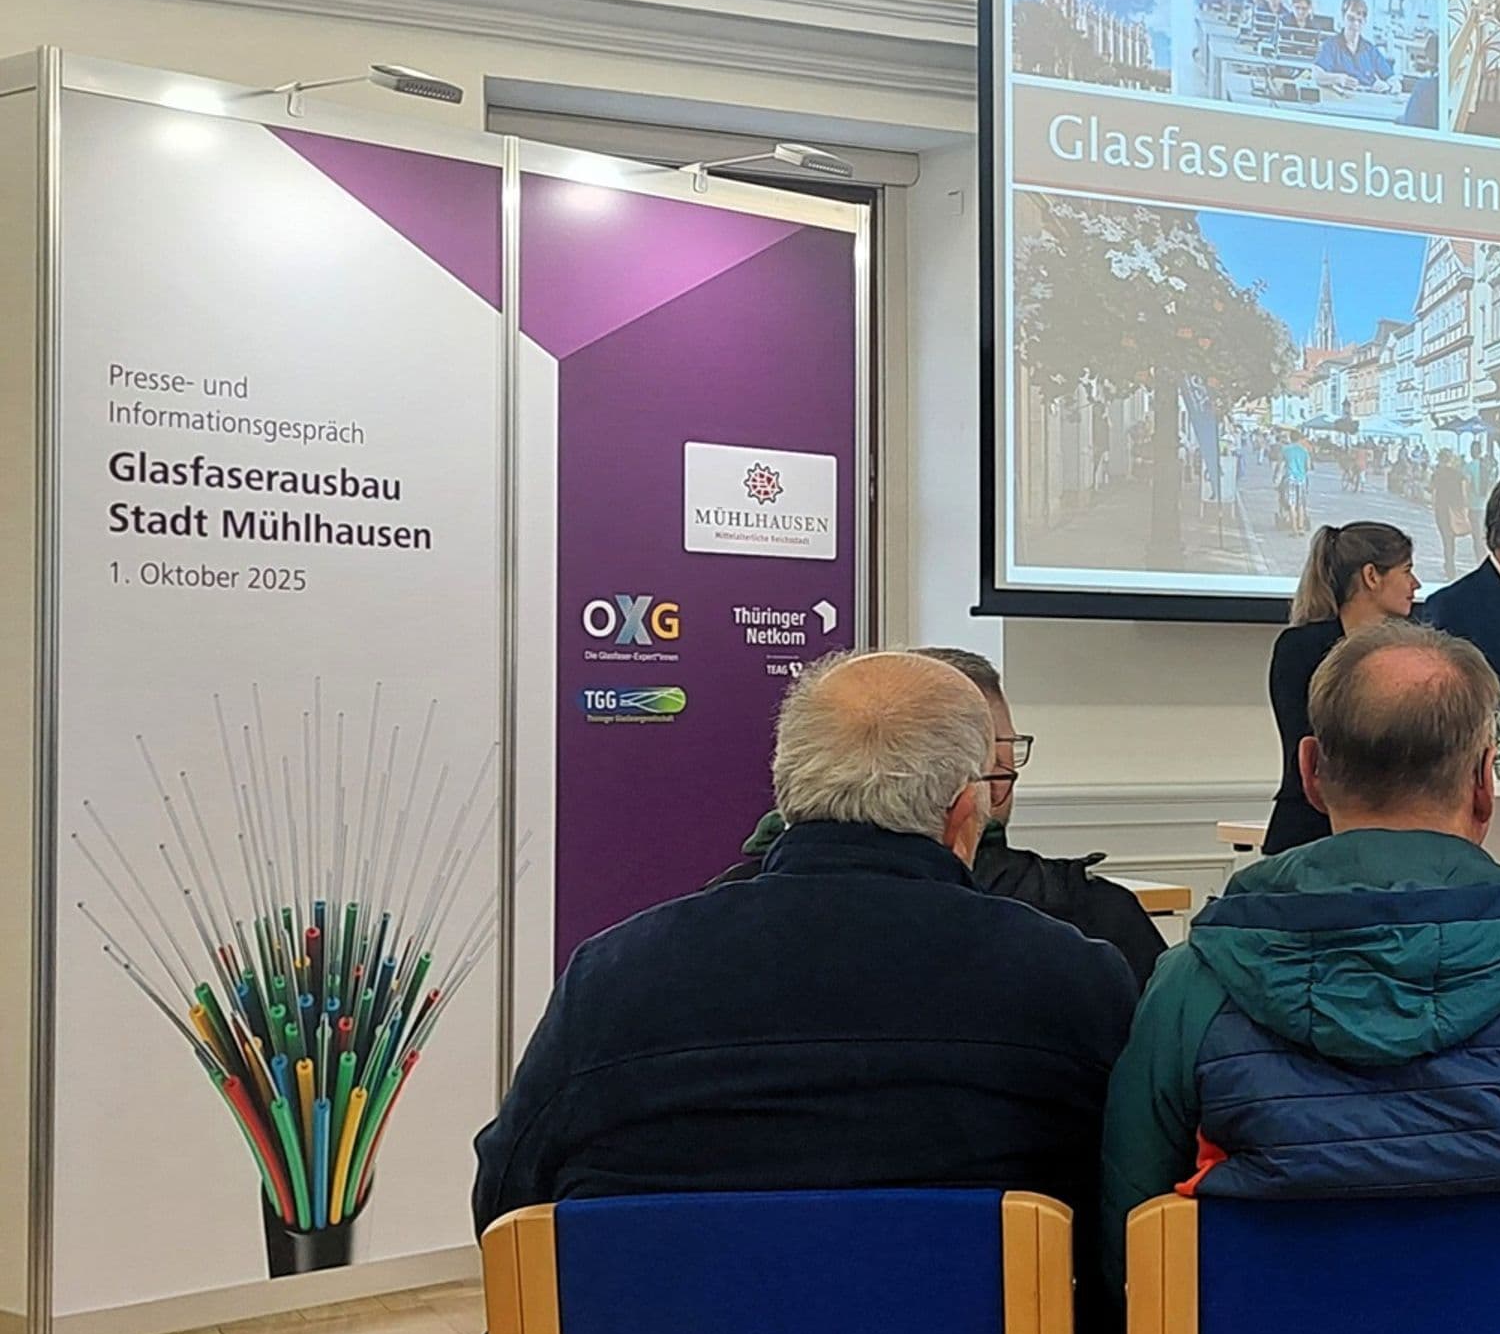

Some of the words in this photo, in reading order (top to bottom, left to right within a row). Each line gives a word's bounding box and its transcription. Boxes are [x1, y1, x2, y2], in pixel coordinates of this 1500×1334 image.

[1049, 114, 1444, 204] Glasfaserausbau
[1463, 167, 1499, 211] in
[109, 364, 195, 393] Presse-
[203, 376, 248, 399] und
[109, 400, 365, 445] Informationsgespräch
[108, 451, 401, 501] Glasfaserausbau
[108, 503, 208, 537] Stadt
[222, 510, 432, 549] Mühlhausen
[695, 507, 829, 533] MÜHLHAUSEN
[109, 561, 130, 584] 1.
[140, 562, 240, 588] Oktober
[247, 568, 306, 591] 2025
[583, 594, 679, 645] OXG
[733, 607, 807, 629] Thüringer
[746, 627, 806, 645] Netkom
[584, 651, 597, 660] Die
[766, 664, 788, 675] TEAG
[584, 690, 617, 709] TGG
